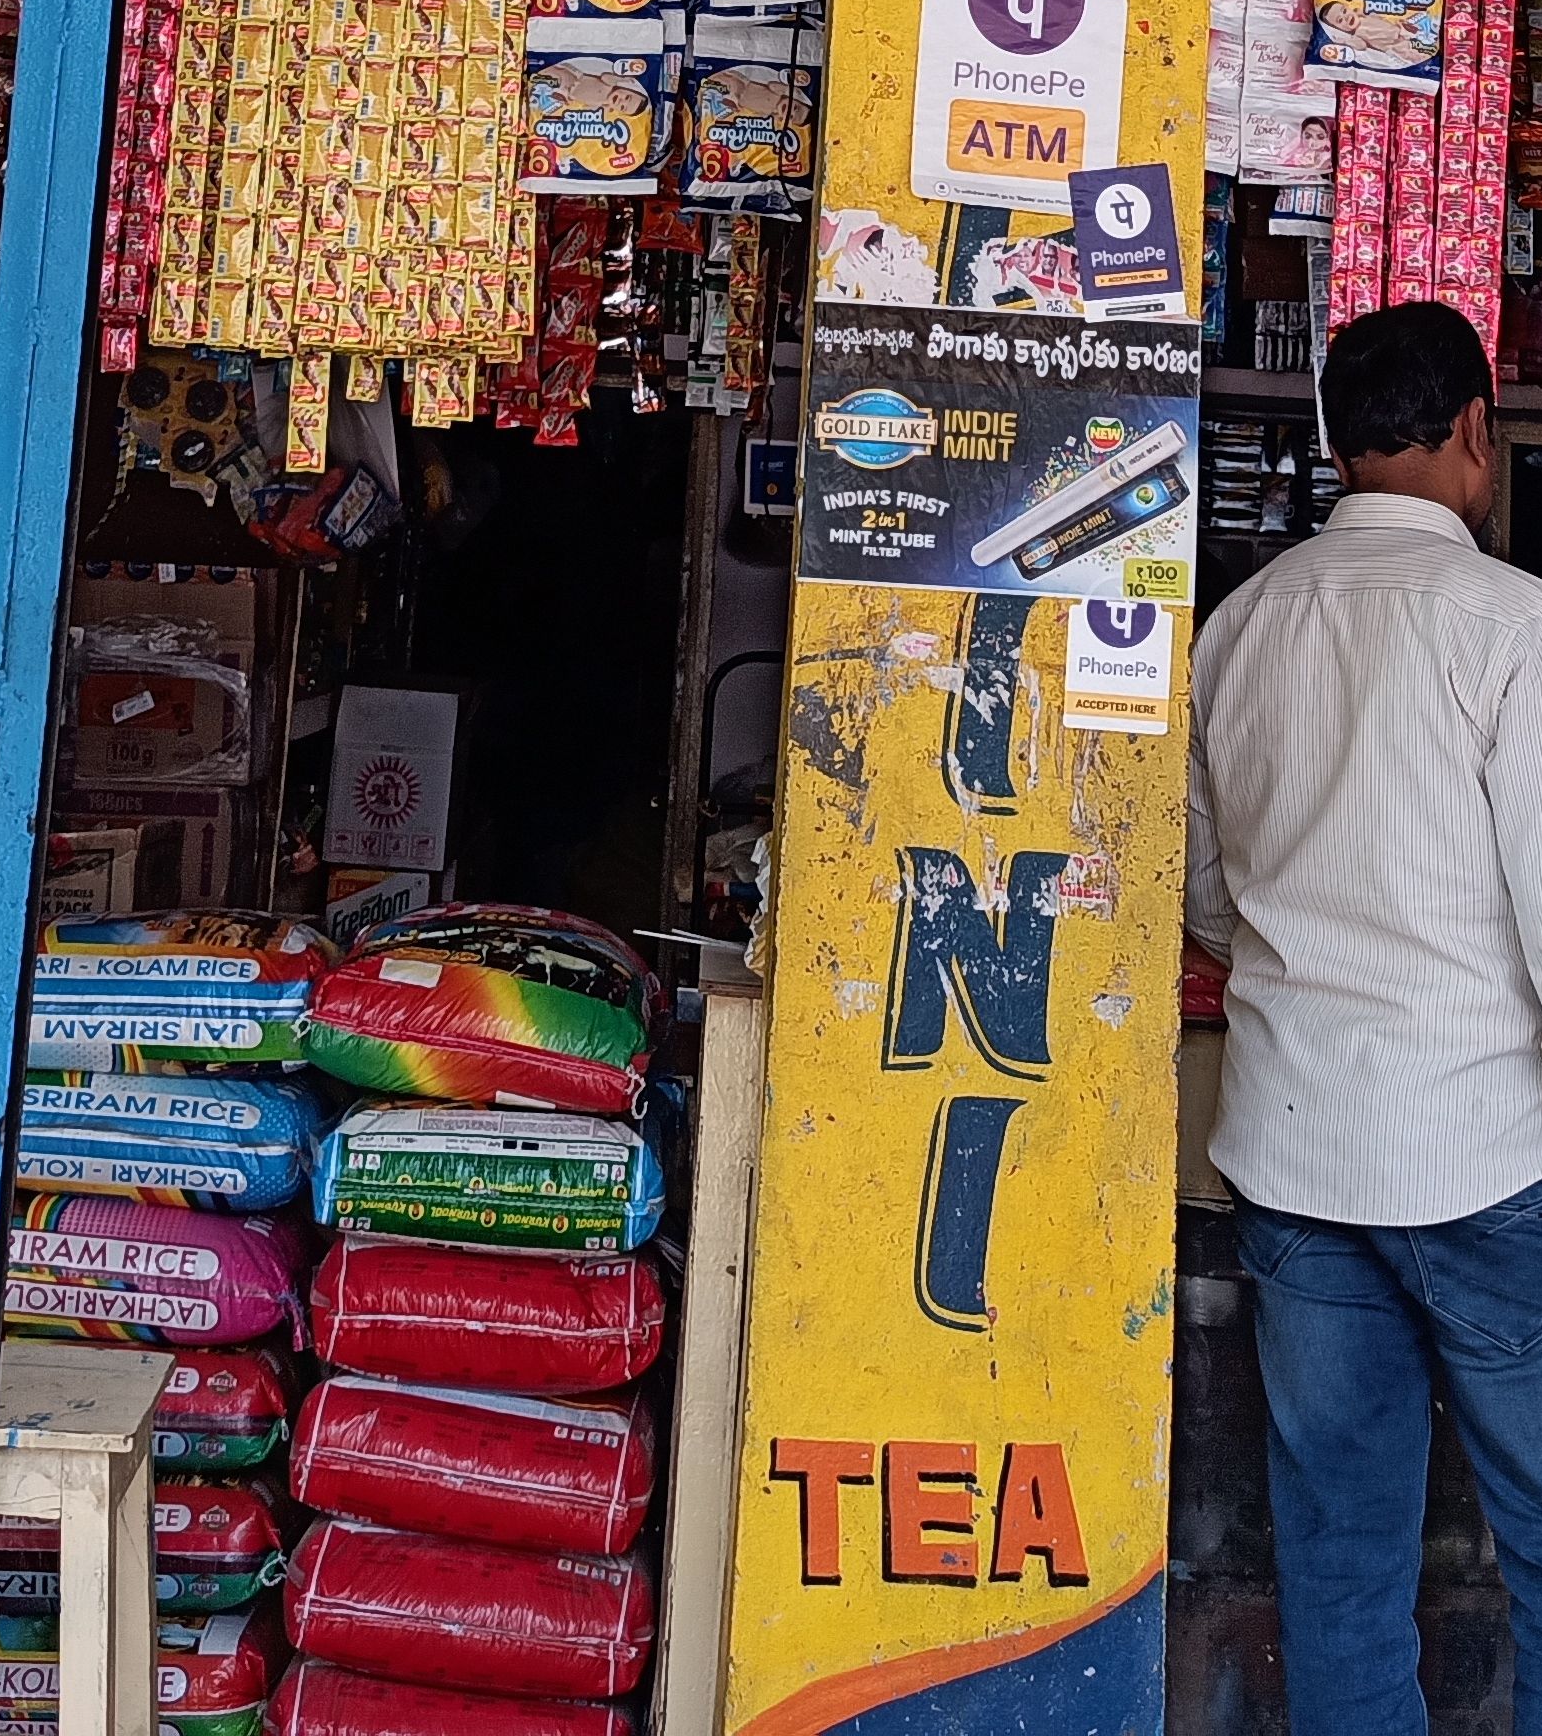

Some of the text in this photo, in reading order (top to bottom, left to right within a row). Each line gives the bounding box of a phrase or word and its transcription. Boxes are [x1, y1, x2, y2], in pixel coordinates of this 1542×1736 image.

[953, 61, 1087, 99] PhonePe
[961, 120, 1068, 165] ATM
[1091, 246, 1167, 268] PhonePe
[821, 418, 933, 440] GOLD FLAKE
[944, 409, 1018, 437] INDIE
[1089, 427, 1122, 442] NEW
[943, 435, 1015, 463] MINT
[823, 489, 950, 517] INDIA'S FIRST
[830, 528, 936, 549] MINT + TUBE
[1057, 508, 1113, 547] INDIE MINT
[862, 546, 901, 558] FILTER
[1127, 583, 1146, 598] 10
[1078, 656, 1158, 679] PhonePe
[1075, 699, 1156, 715] ACCEPTED HERE
[55, 901, 93, 914] PACK
[330, 887, 410, 940] Freedom
[97, 958, 252, 979] KOLAM RICE
[44, 1018, 248, 1042] JAI SRIRAM
[23, 1087, 247, 1125] SRIRAM RICE
[18, 1157, 239, 1191] LACHKARI KOLA
[9, 1235, 199, 1276] IRAM RICE
[769, 1437, 1090, 1588] TEA
